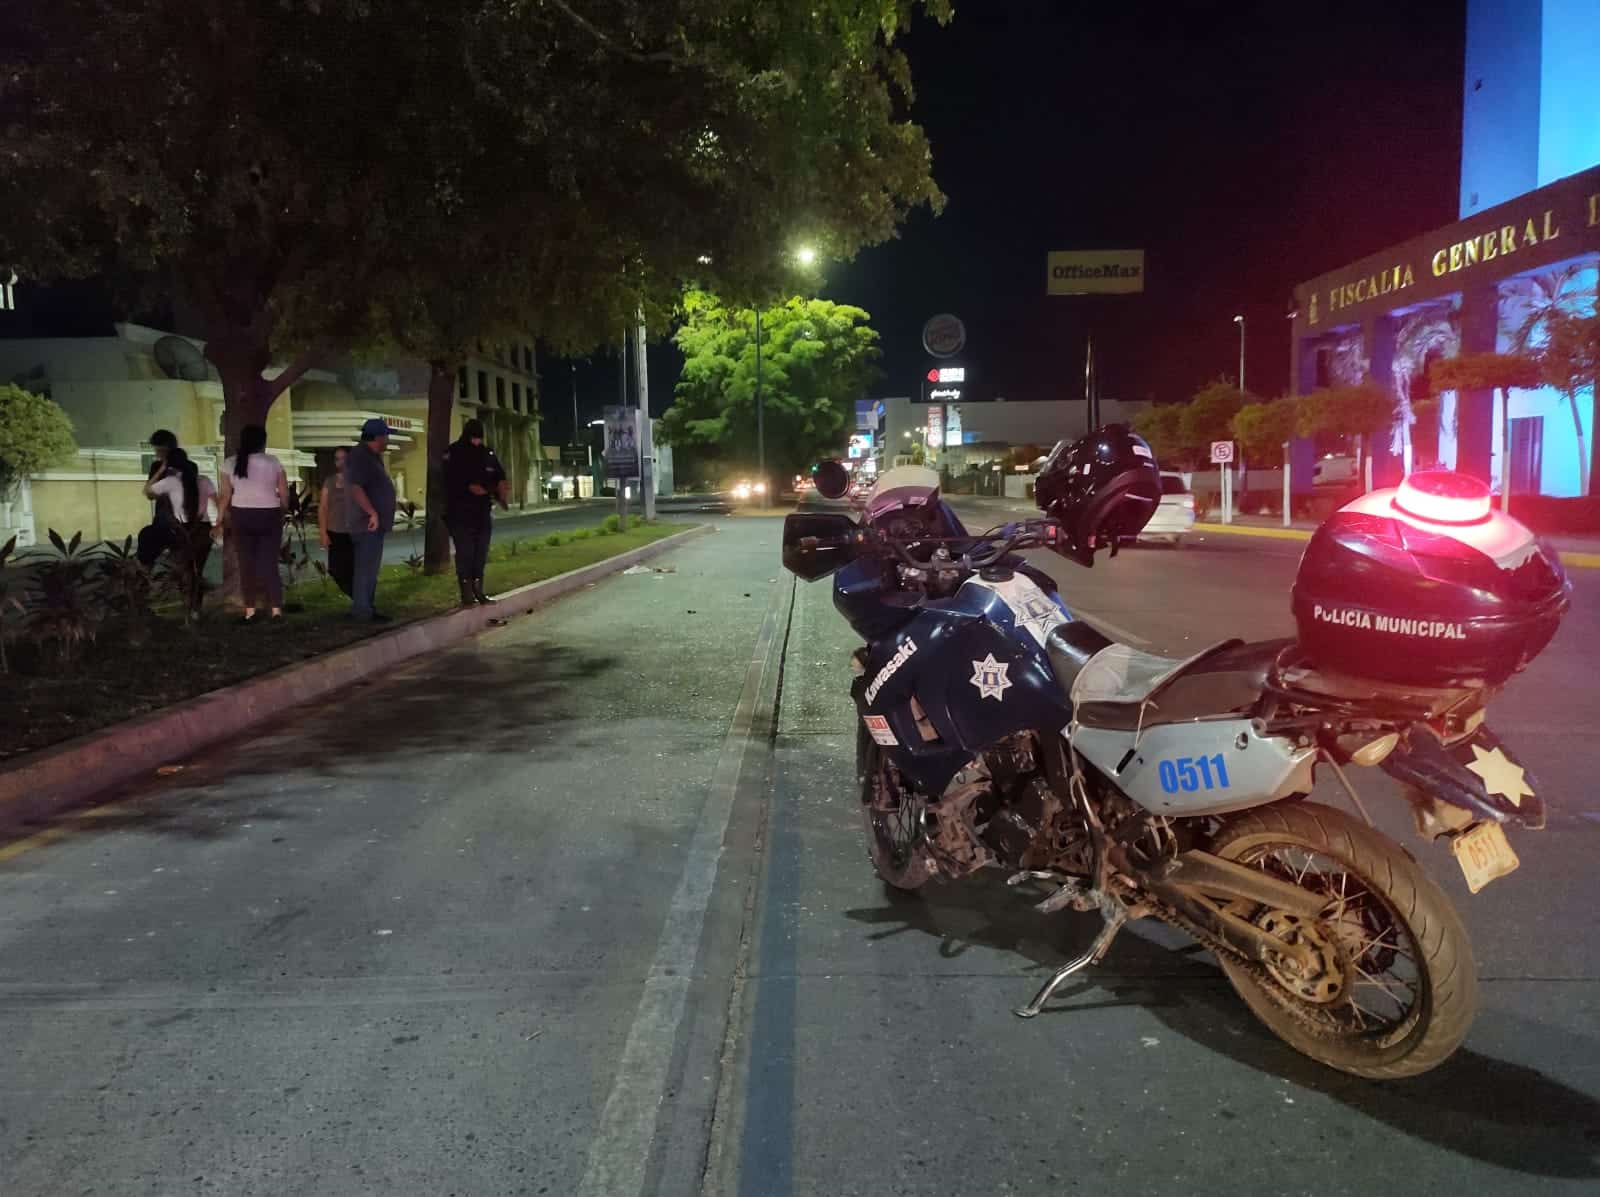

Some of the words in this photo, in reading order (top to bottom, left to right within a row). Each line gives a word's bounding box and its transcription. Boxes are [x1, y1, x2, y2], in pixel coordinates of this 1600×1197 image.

[1432, 210, 1559, 277] GENERAL
[1053, 264, 1140, 279] OfficeMax
[1375, 616, 1467, 639] MUNICIPAL
[864, 636, 918, 706] Kawasaki
[1158, 753, 1230, 793] 0511
